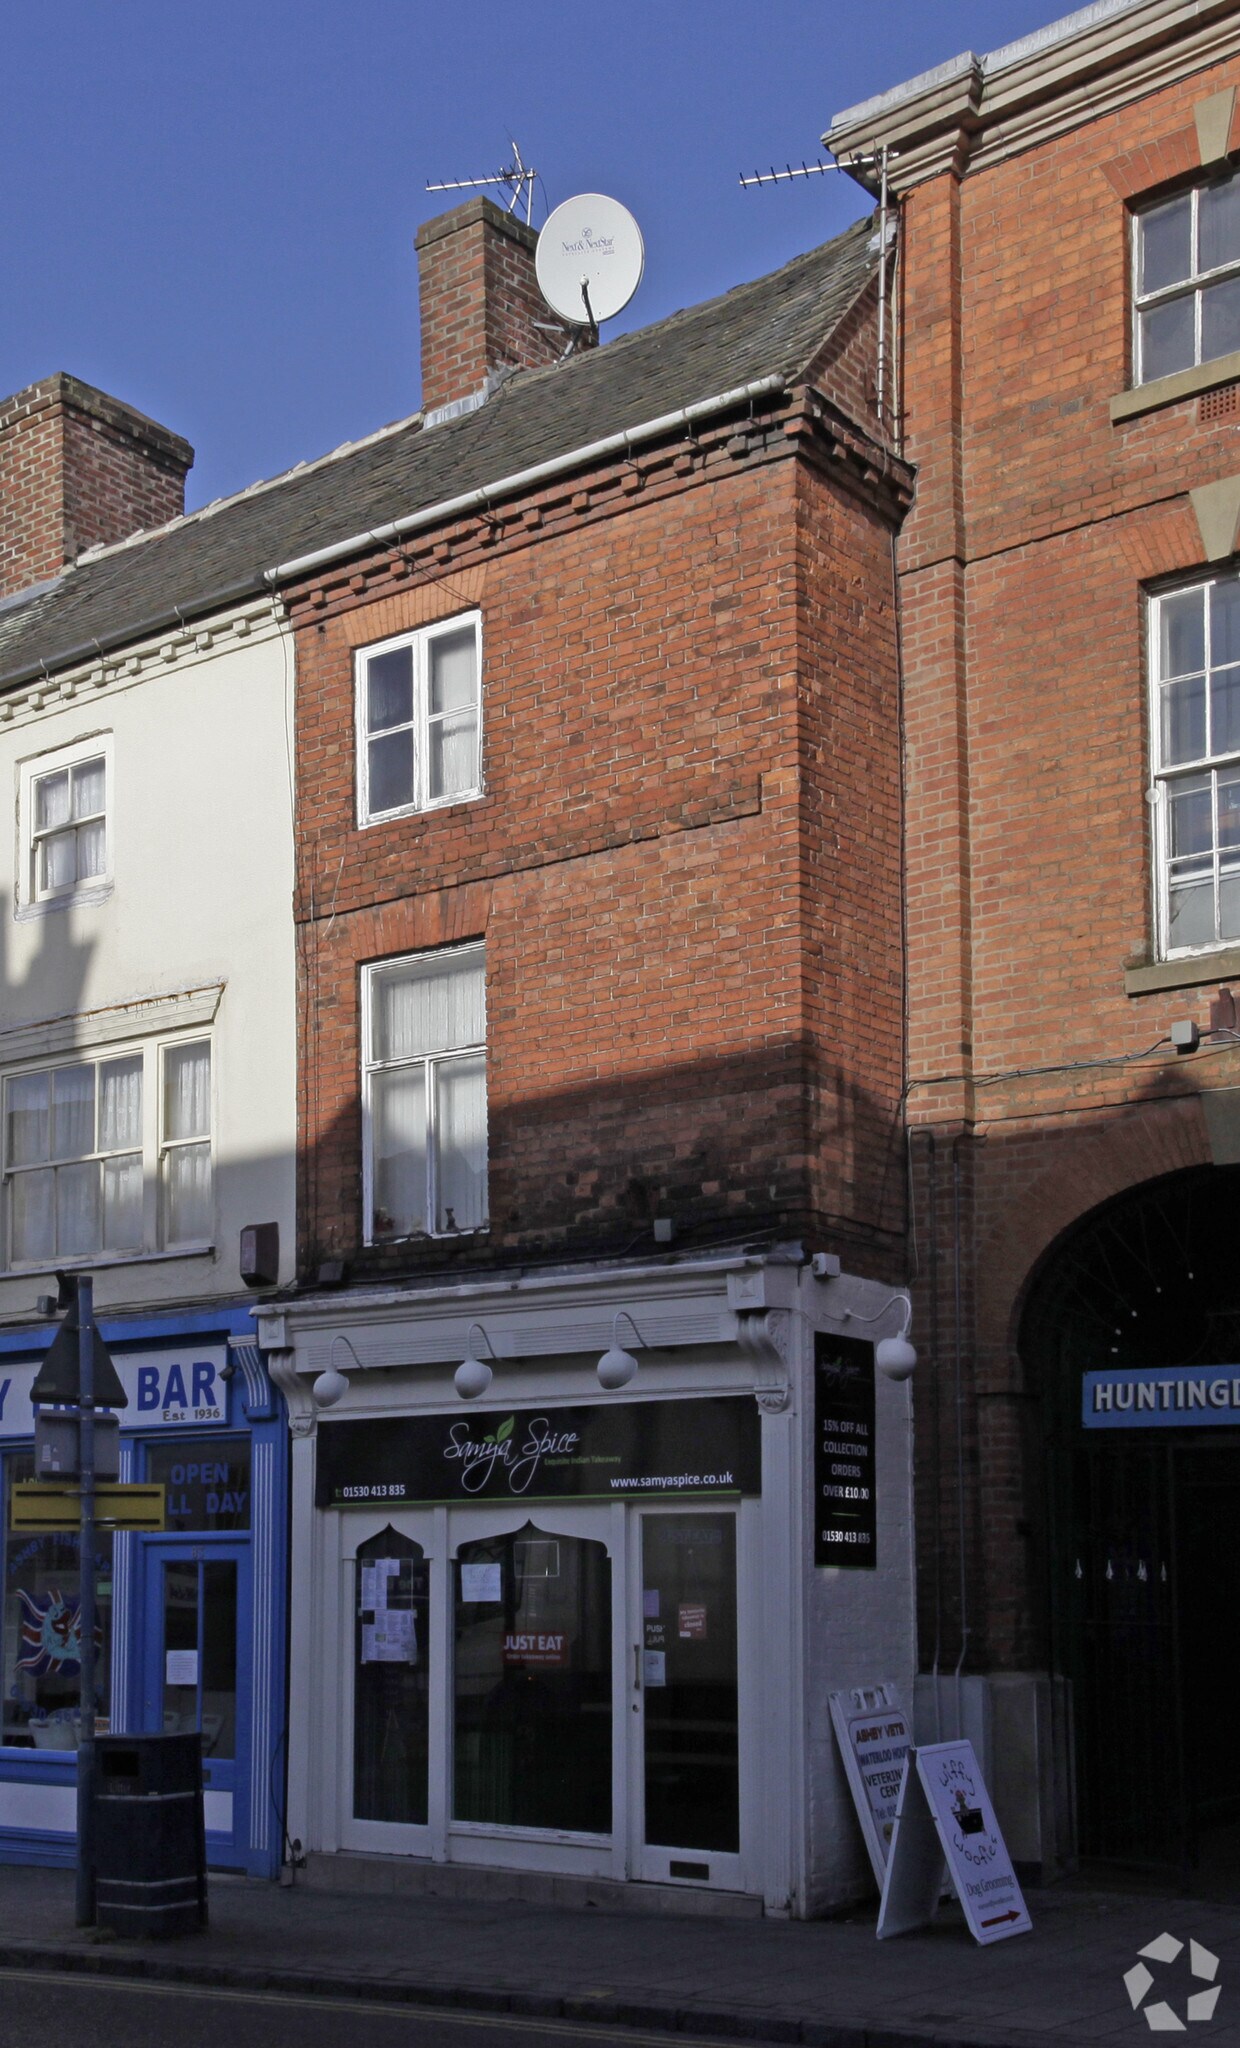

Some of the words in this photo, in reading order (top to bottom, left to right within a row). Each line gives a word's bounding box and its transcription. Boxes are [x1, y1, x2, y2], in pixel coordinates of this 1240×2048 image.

[137, 1362, 217, 1411] BAR
[162, 1410, 185, 1422] Est
[194, 1408, 220, 1420] 1936
[823, 1419, 840, 1432] 15%
[840, 1421, 855, 1433] OFF
[855, 1423, 869, 1436] ALL
[443, 1422, 518, 1492] Samya
[509, 1417, 580, 1493] Spice
[823, 1441, 868, 1457] COLLECTION
[170, 1462, 229, 1486] OPEN
[831, 1463, 861, 1478] ORDERS
[609, 1471, 734, 1489] www.samyaspice.co.uk
[342, 1485, 370, 1498] 01530
[371, 1484, 387, 1497] 413
[388, 1483, 406, 1496] 835
[822, 1484, 844, 1498] OVER
[844, 1486, 870, 1500] £10.00
[167, 1493, 193, 1516] LL
[206, 1491, 247, 1514] DAY
[822, 1529, 844, 1543] 01530
[844, 1531, 857, 1543] 413
[857, 1532, 871, 1544] 835
[503, 1635, 536, 1651] JUST
[537, 1635, 564, 1651] EAT
[855, 1725, 883, 1744] ASHBY
[879, 1783, 901, 1799] CENT
[965, 1882, 983, 1898] Dog
[980, 1874, 1015, 1893] Grooming
